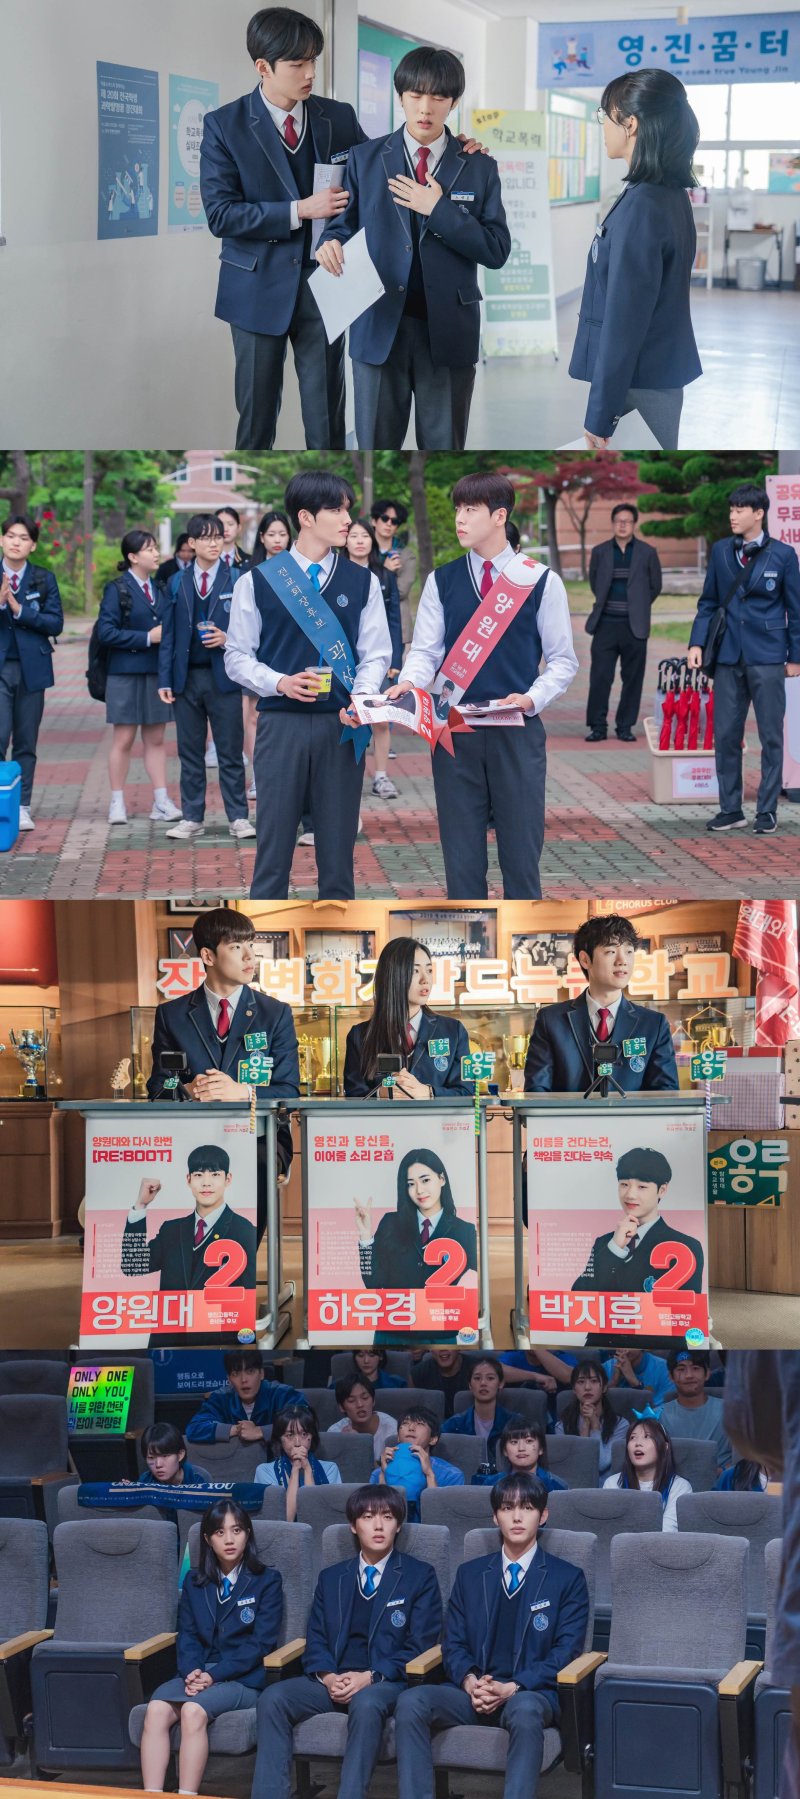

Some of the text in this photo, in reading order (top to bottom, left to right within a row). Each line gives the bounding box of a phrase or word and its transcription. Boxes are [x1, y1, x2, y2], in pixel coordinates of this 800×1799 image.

[715, 67, 735, 75] true
[739, 66, 769, 74] Young
[773, 65, 788, 73] Jin
[476, 111, 499, 124] stop
[186, 127, 203, 137] 학교폭
[492, 128, 542, 146] 학교폭력
[502, 178, 537, 190] 입니다
[462, 593, 515, 663] 양원대
[615, 900, 653, 910] CHORUS
[92, 1136, 173, 1147] 양원대와 다시 한번
[314, 1135, 394, 1147] 영진과 당신을,
[567, 1136, 612, 1148] 건다는건,
[92, 1150, 172, 1163] [RE:BOOT]
[314, 1151, 346, 1162] 이어줄
[349, 1150, 371, 1162] 소리
[533, 1151, 613, 1162] 책임을 진다는 약속
[204, 1239, 248, 1303] 2
[424, 1237, 467, 1301] 2
[650, 1241, 697, 1306] 2
[92, 1294, 194, 1329] 양원대
[318, 1292, 417, 1326] 하유경
[539, 1294, 643, 1329] 박지훈
[74, 1371, 128, 1382] ONLY ONE
[72, 1386, 126, 1397] ONLY YOU
[70, 1401, 124, 1413] 나를 위한 선택
